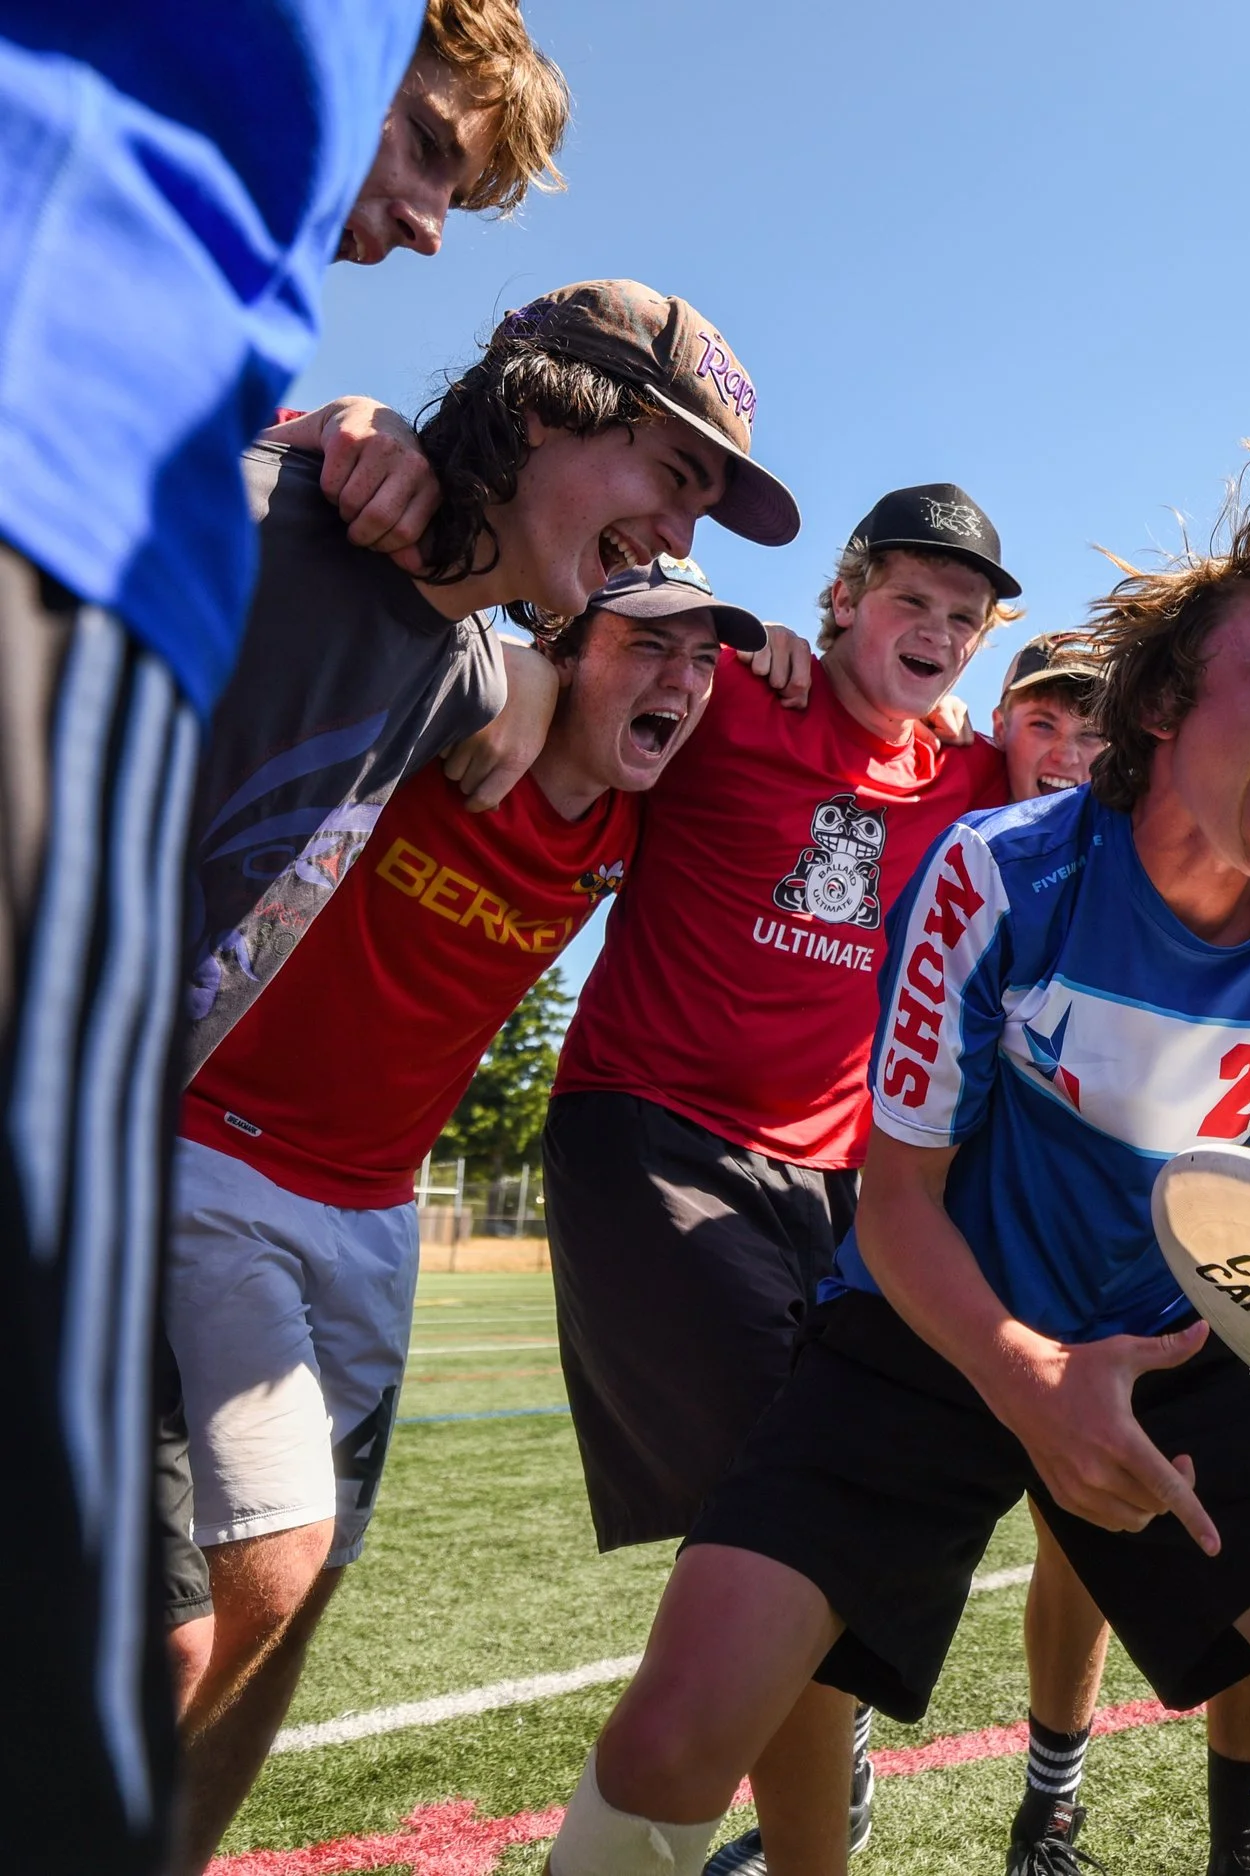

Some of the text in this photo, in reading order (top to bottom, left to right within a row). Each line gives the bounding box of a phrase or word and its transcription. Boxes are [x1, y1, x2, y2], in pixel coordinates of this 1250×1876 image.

[696, 332, 756, 430] Rap
[813, 889, 853, 912] ULTIMATE
[818, 864, 856, 886] BALLARD
[753, 917, 874, 972] ULTIMATE
[884, 843, 985, 1108] SHOW
